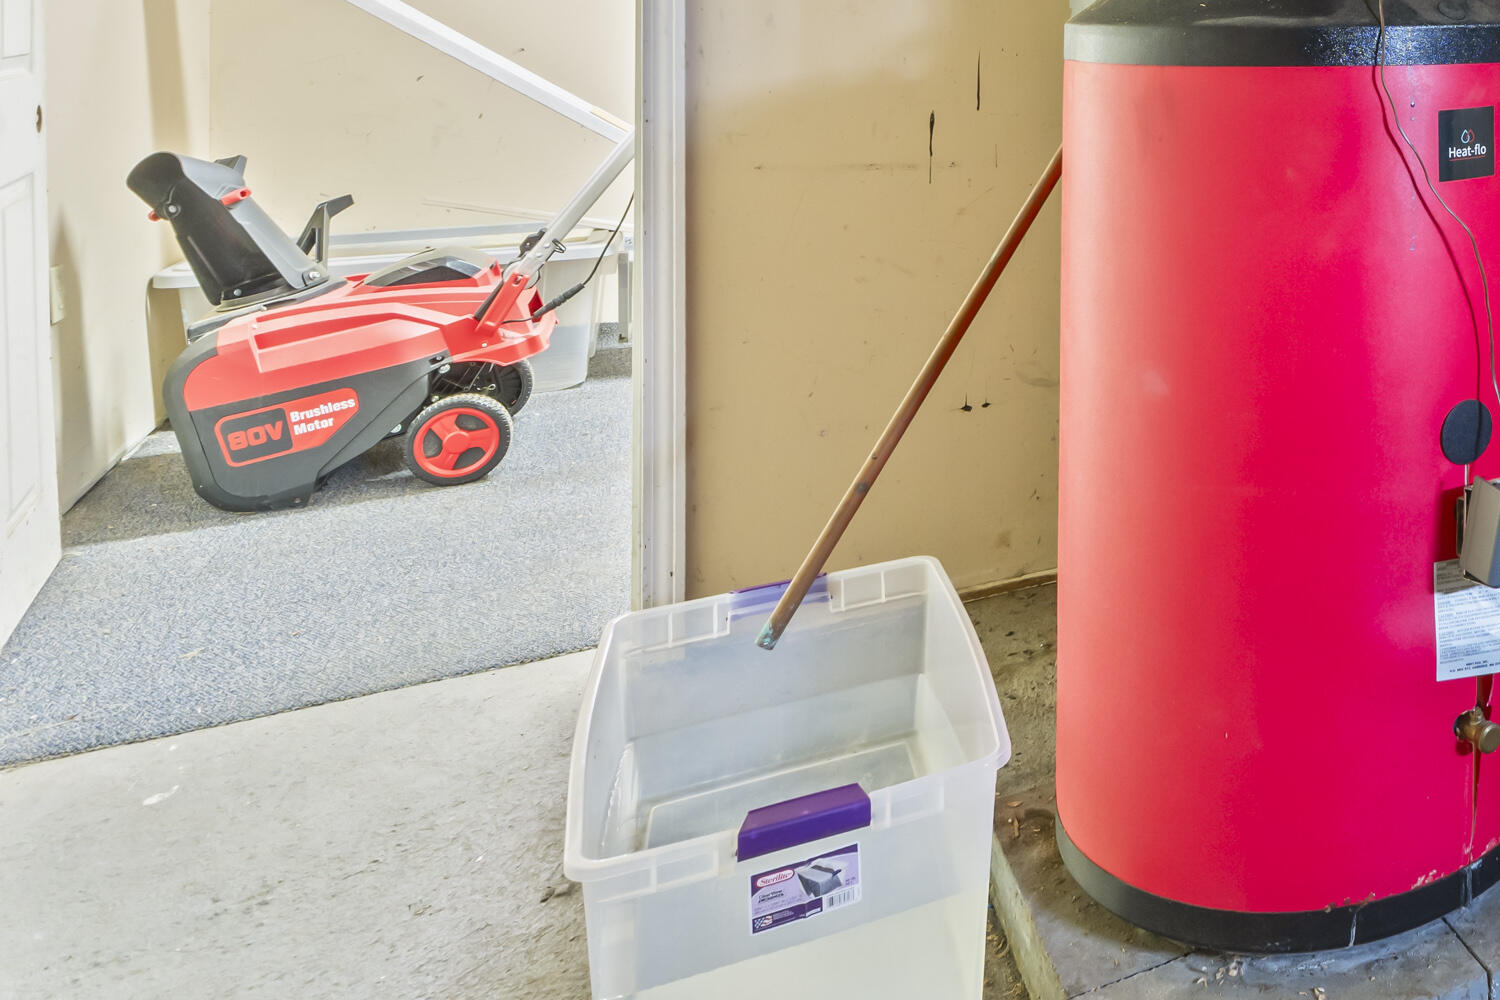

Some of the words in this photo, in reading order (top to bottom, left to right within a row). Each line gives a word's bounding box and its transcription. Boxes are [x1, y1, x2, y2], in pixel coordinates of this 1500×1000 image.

[1448, 143, 1487, 159] Heat-flo
[290, 398, 356, 423] Brushless
[227, 420, 283, 451] 80V
[293, 417, 334, 436] Motor
